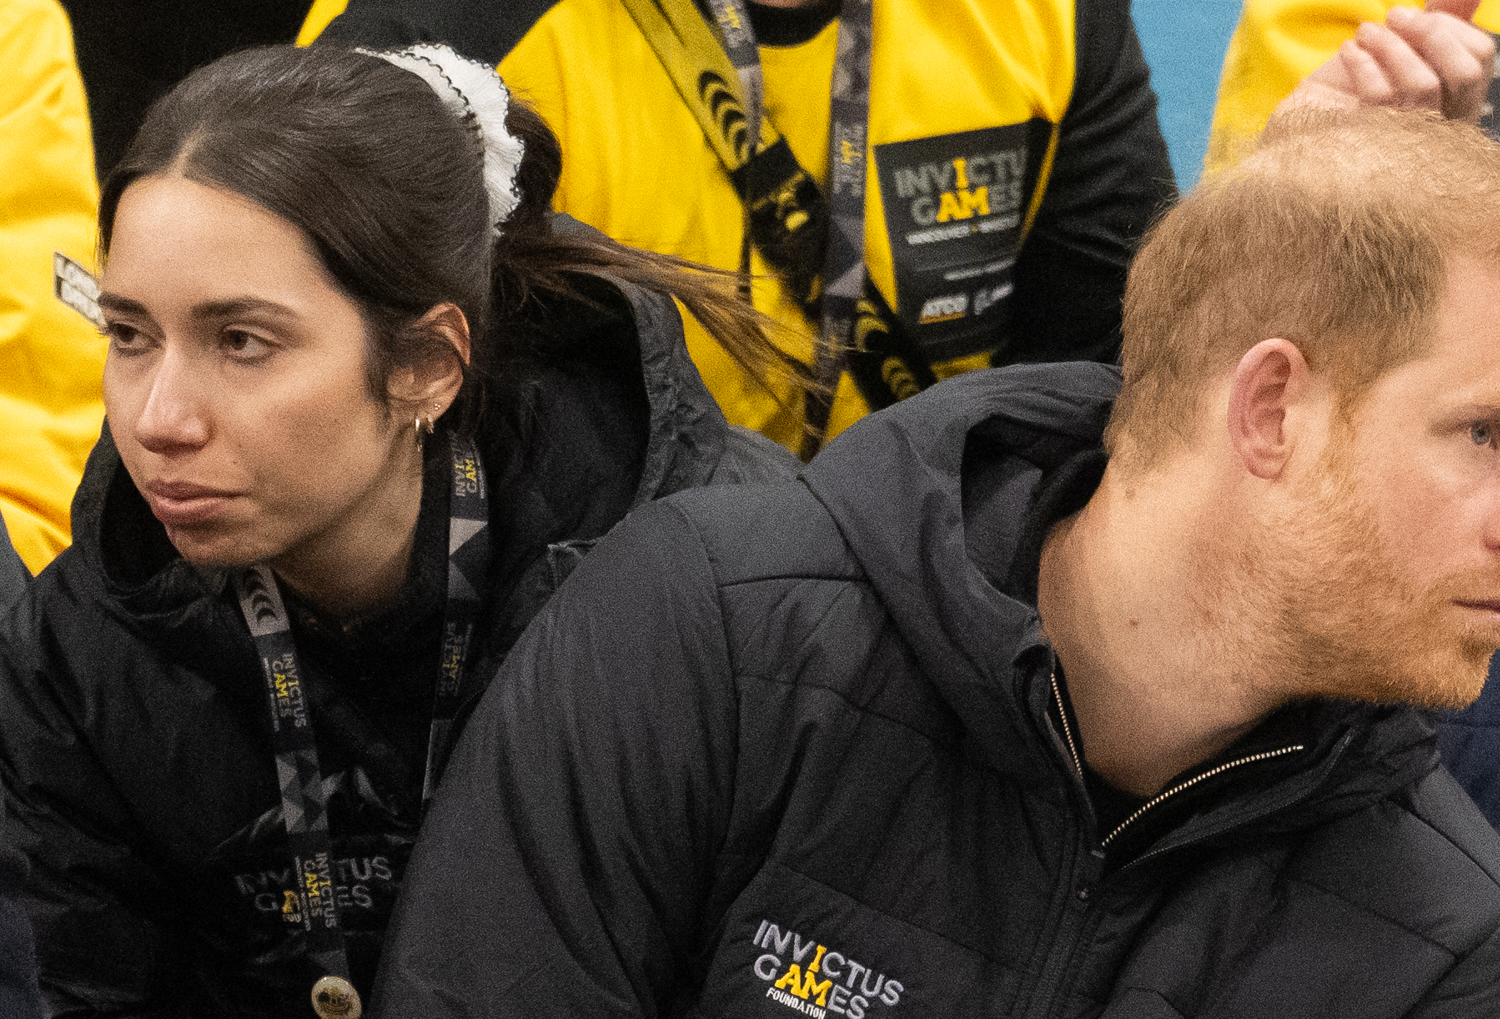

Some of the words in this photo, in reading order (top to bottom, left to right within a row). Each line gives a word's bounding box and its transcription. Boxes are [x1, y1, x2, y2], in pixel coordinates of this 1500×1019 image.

[272, 660, 292, 718] GAMES
[282, 653, 307, 728] INVICTUS
[303, 859, 323, 917] GAMES
[315, 852, 337, 929] INVICTUS
[752, 919, 904, 1007] INVICTUS
